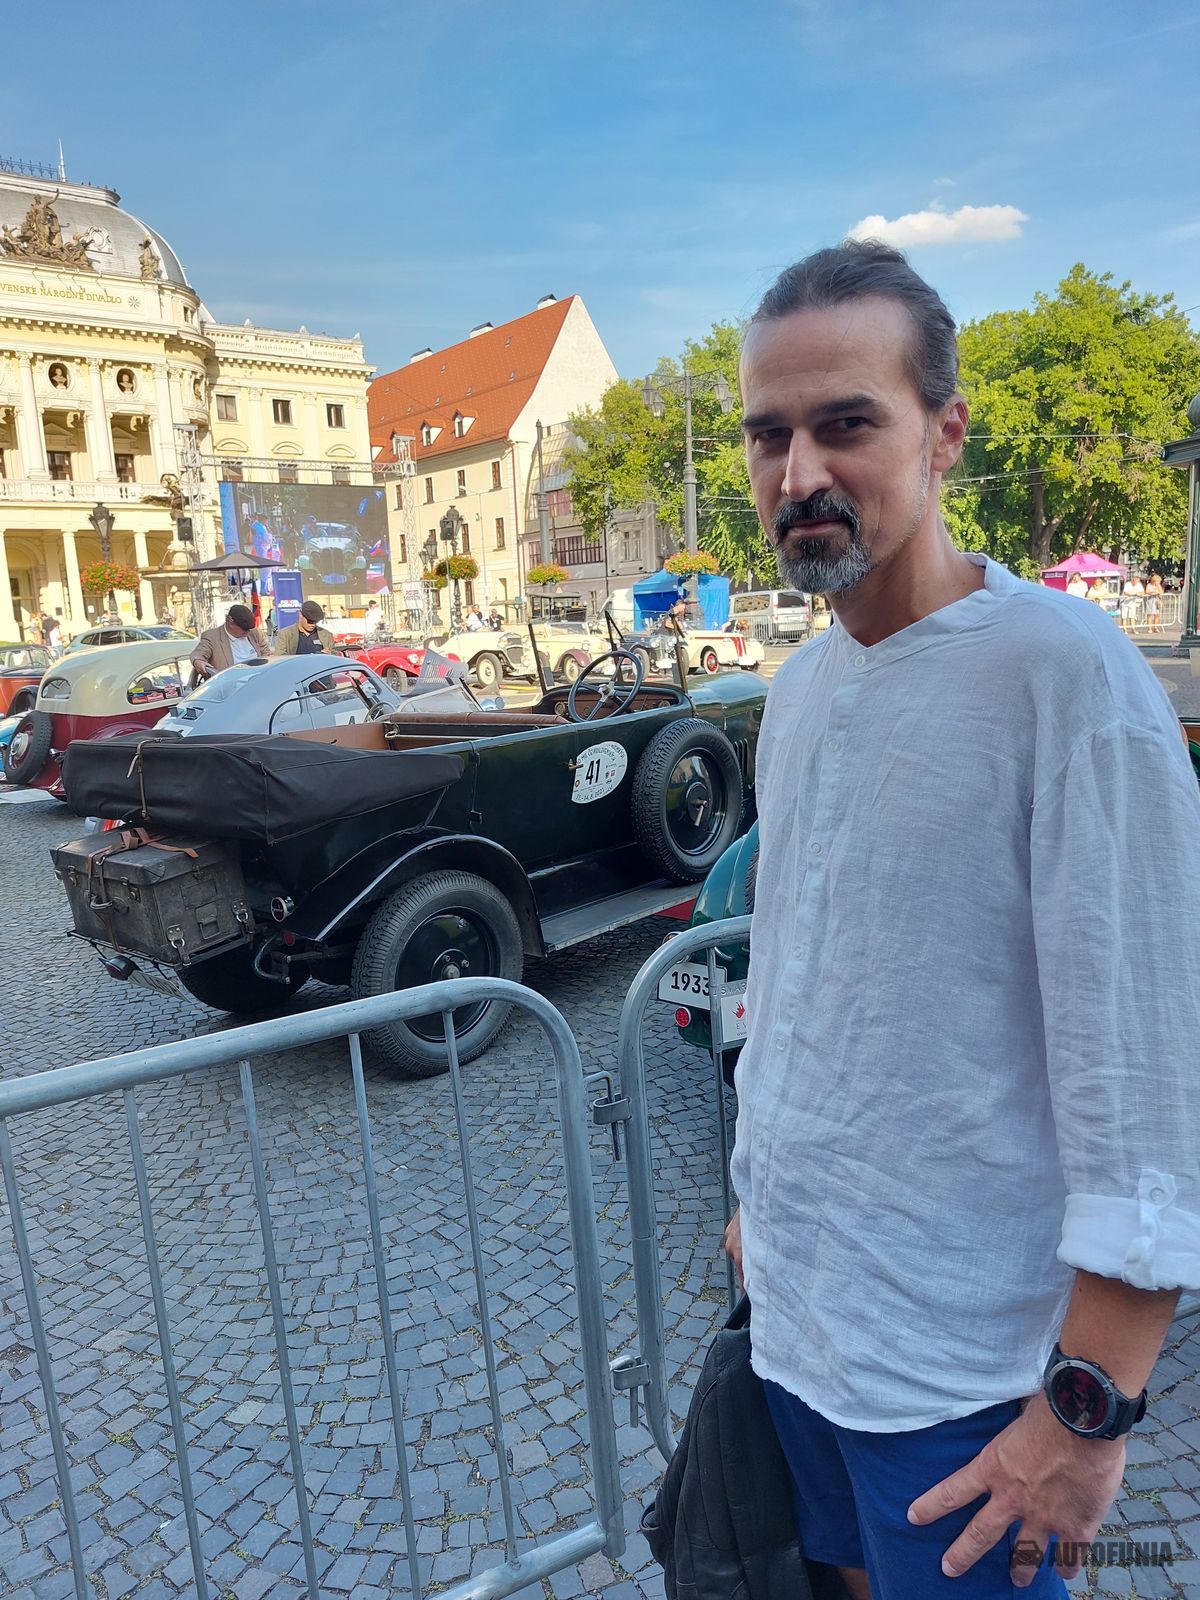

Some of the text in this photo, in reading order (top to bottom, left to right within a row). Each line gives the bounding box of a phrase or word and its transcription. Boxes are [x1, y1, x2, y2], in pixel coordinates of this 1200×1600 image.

[86, 293, 122, 304] DIVADLO
[586, 759, 600, 785] 41
[671, 971, 710, 996] 1933
